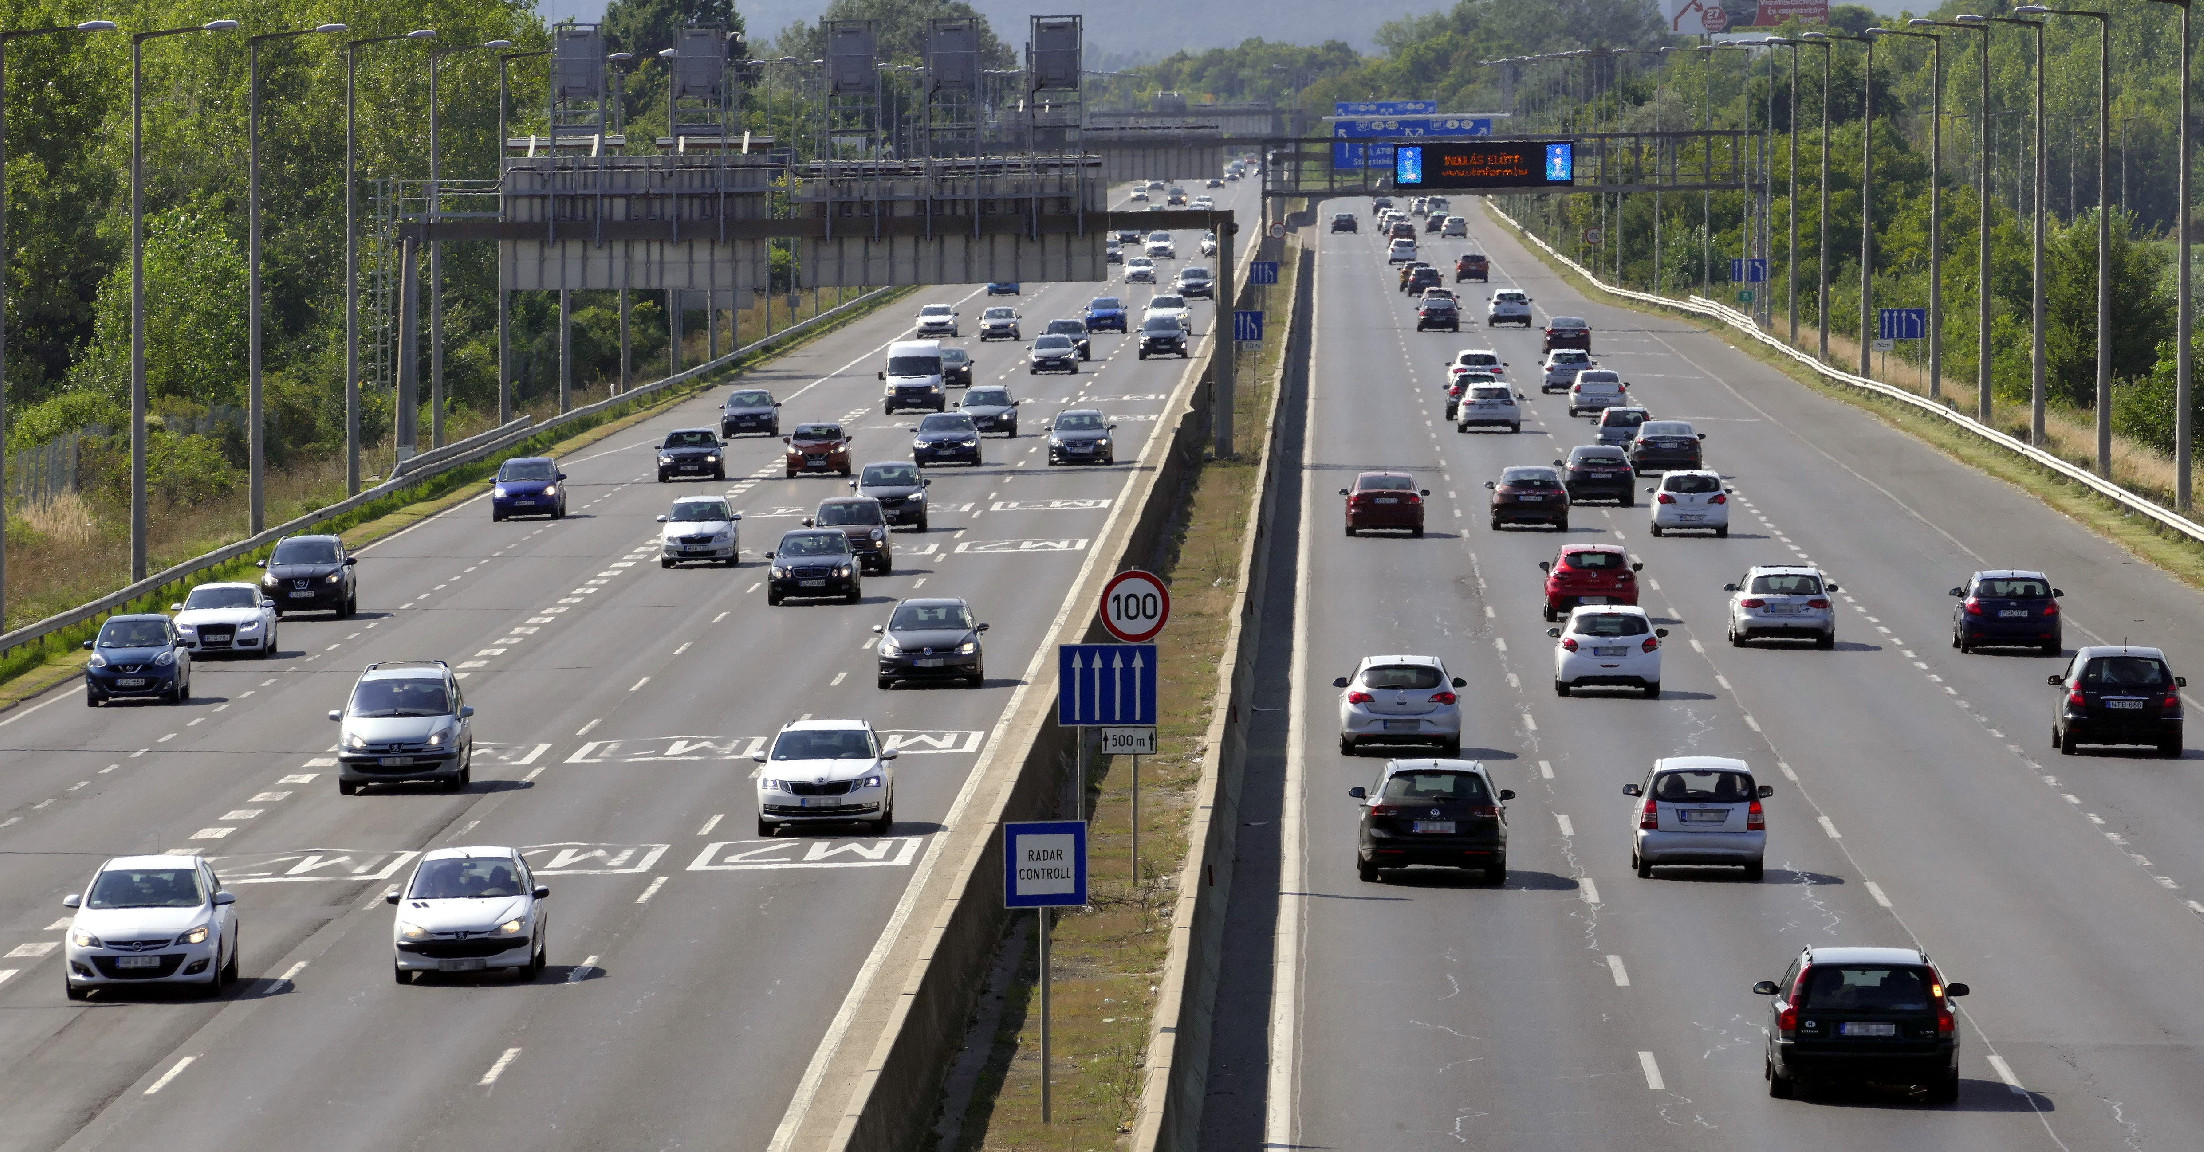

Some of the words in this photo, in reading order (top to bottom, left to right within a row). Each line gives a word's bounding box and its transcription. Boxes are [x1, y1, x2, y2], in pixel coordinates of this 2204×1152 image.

[1112, 593, 1158, 621] 100
[1112, 734, 1134, 748] 500
[1136, 737, 1145, 748] m
[724, 840, 893, 863] M7
[1028, 849, 1063, 862] RADAR
[1019, 867, 1071, 881] CONTROLL
